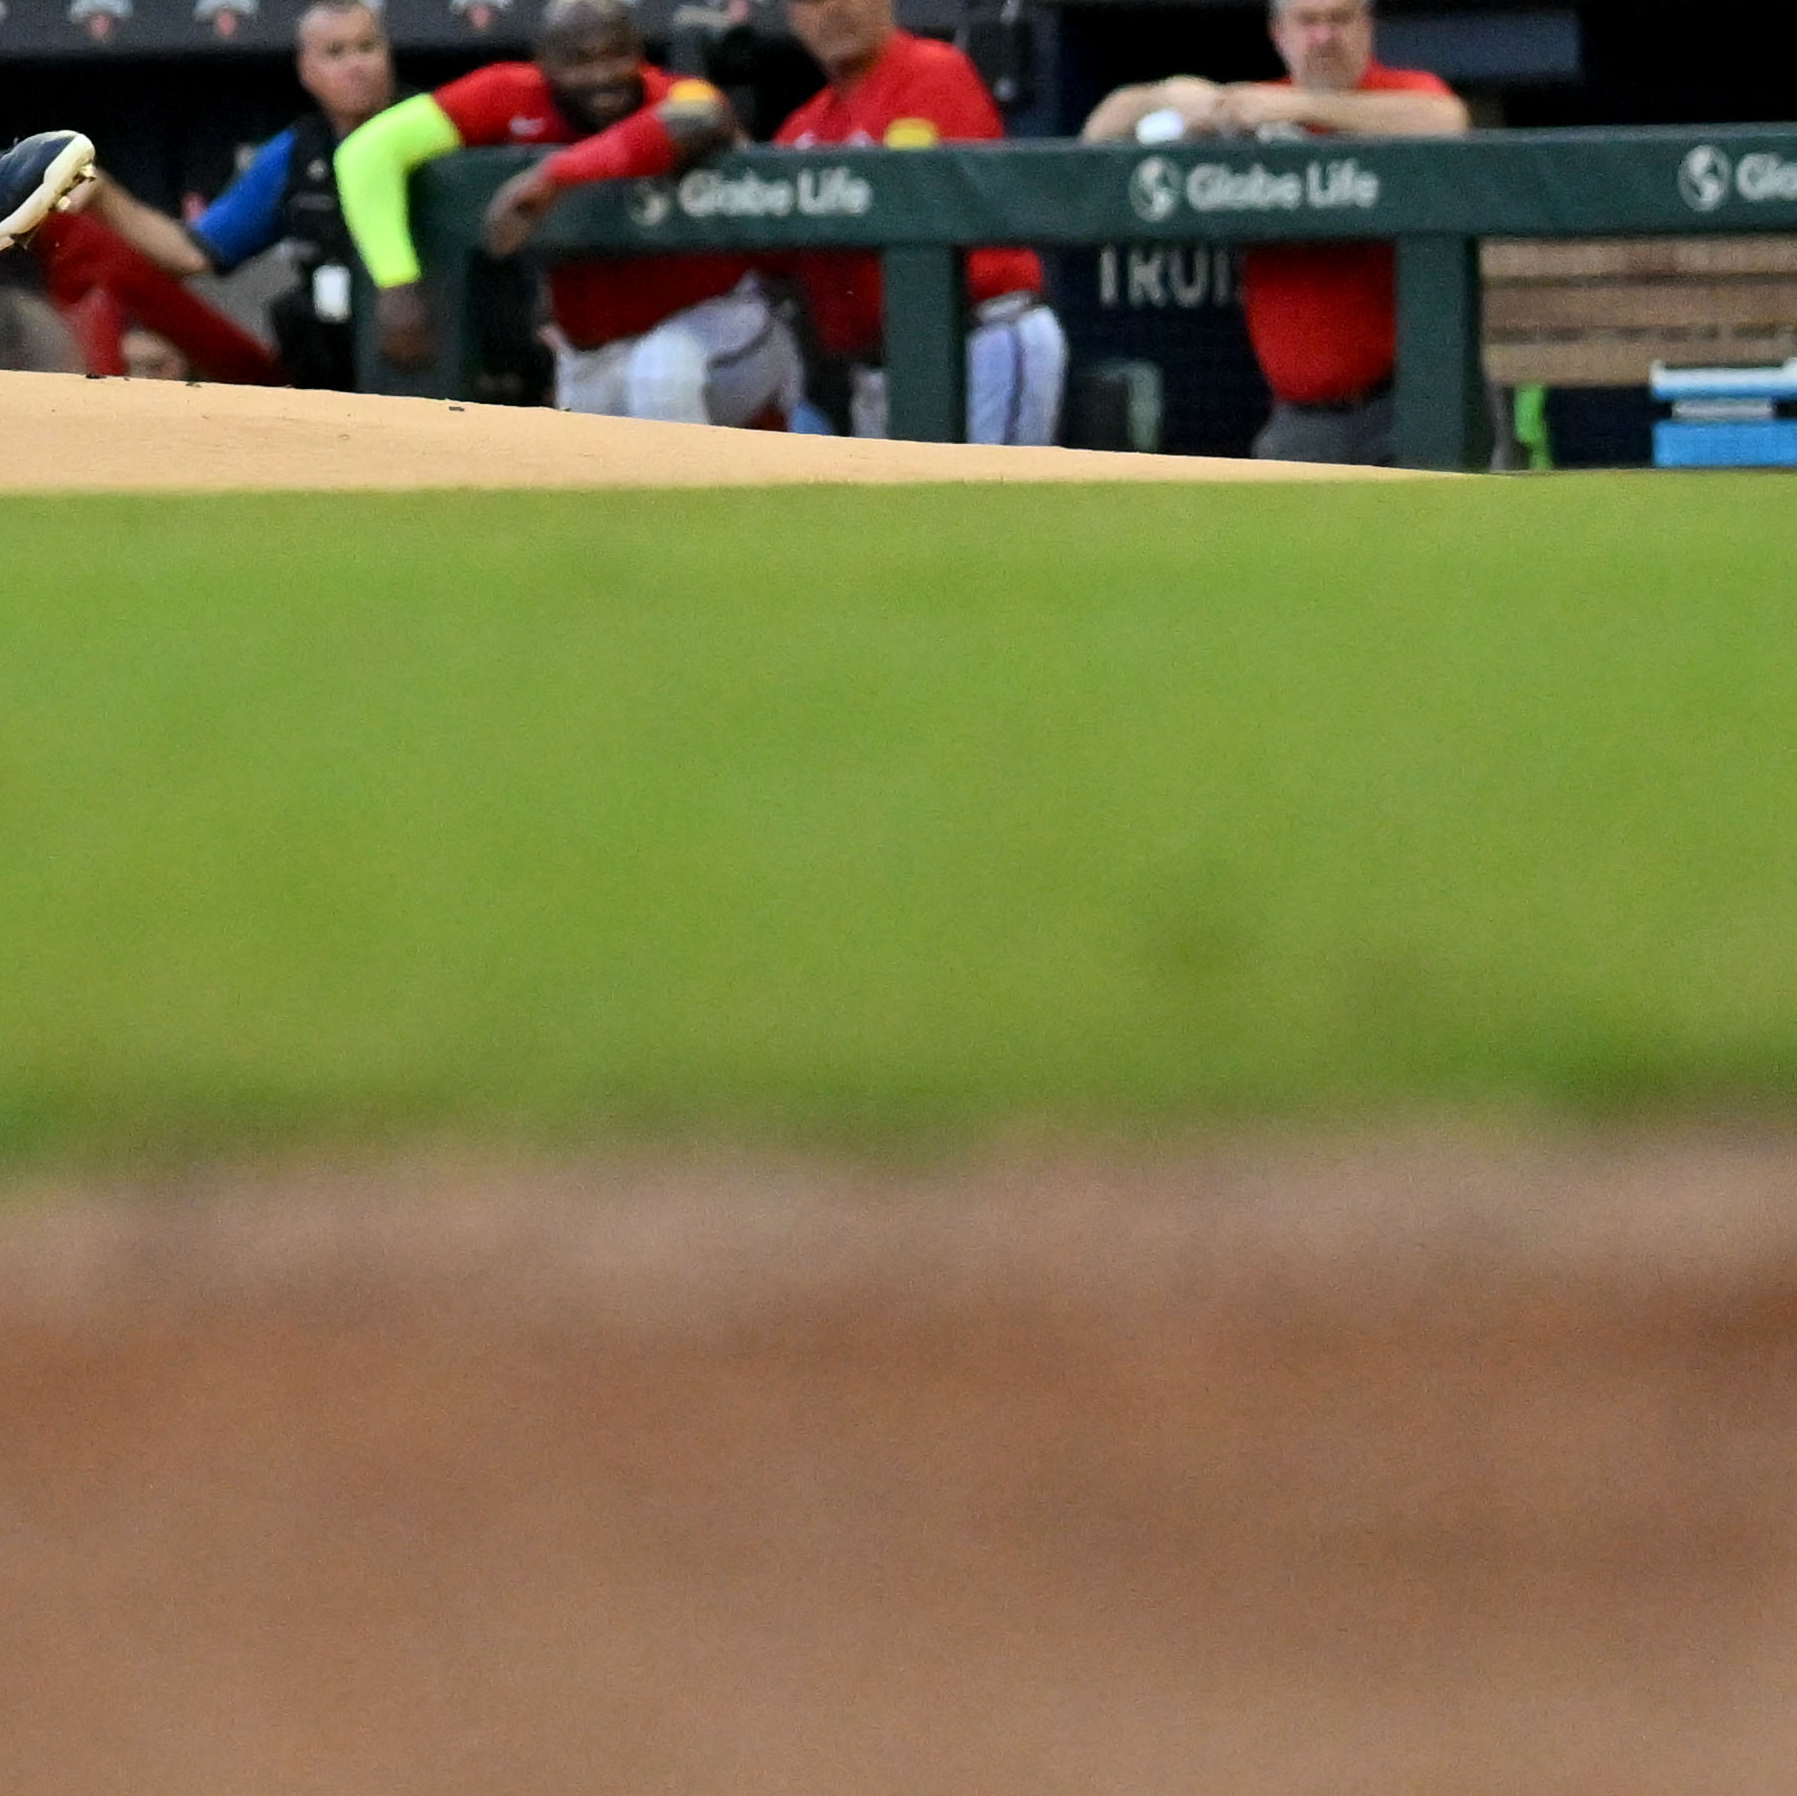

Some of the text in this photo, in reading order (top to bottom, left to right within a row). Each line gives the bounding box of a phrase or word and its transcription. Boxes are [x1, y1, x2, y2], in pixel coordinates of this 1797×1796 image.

[678, 167, 872, 217] Globe Life
[1186, 159, 1380, 212] Globe Life
